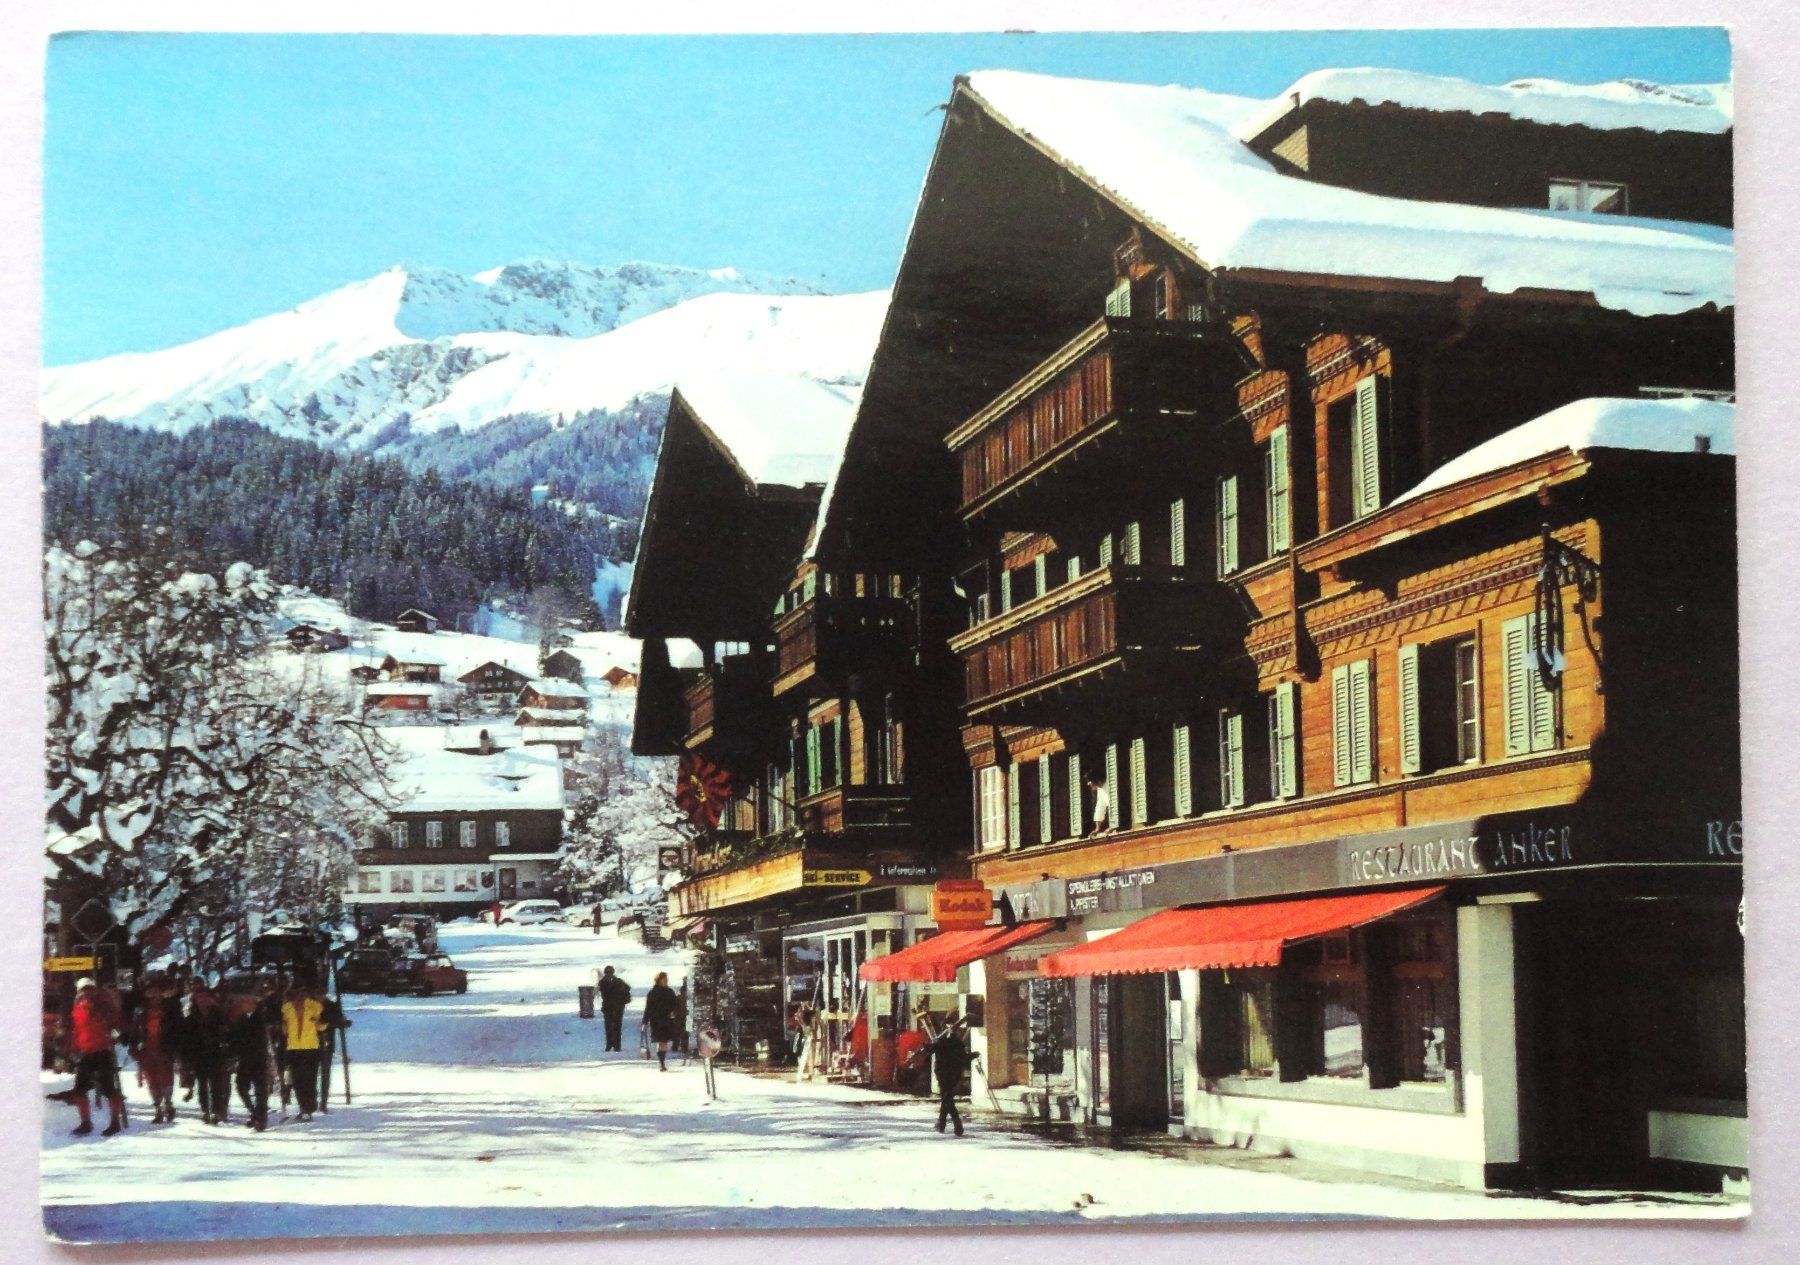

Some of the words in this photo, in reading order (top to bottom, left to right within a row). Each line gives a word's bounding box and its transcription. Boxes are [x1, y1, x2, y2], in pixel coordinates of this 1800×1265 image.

[1350, 836, 1479, 881] RESTAURANT
[1494, 822, 1573, 867] ANKER
[939, 898, 986, 912] Kodak
